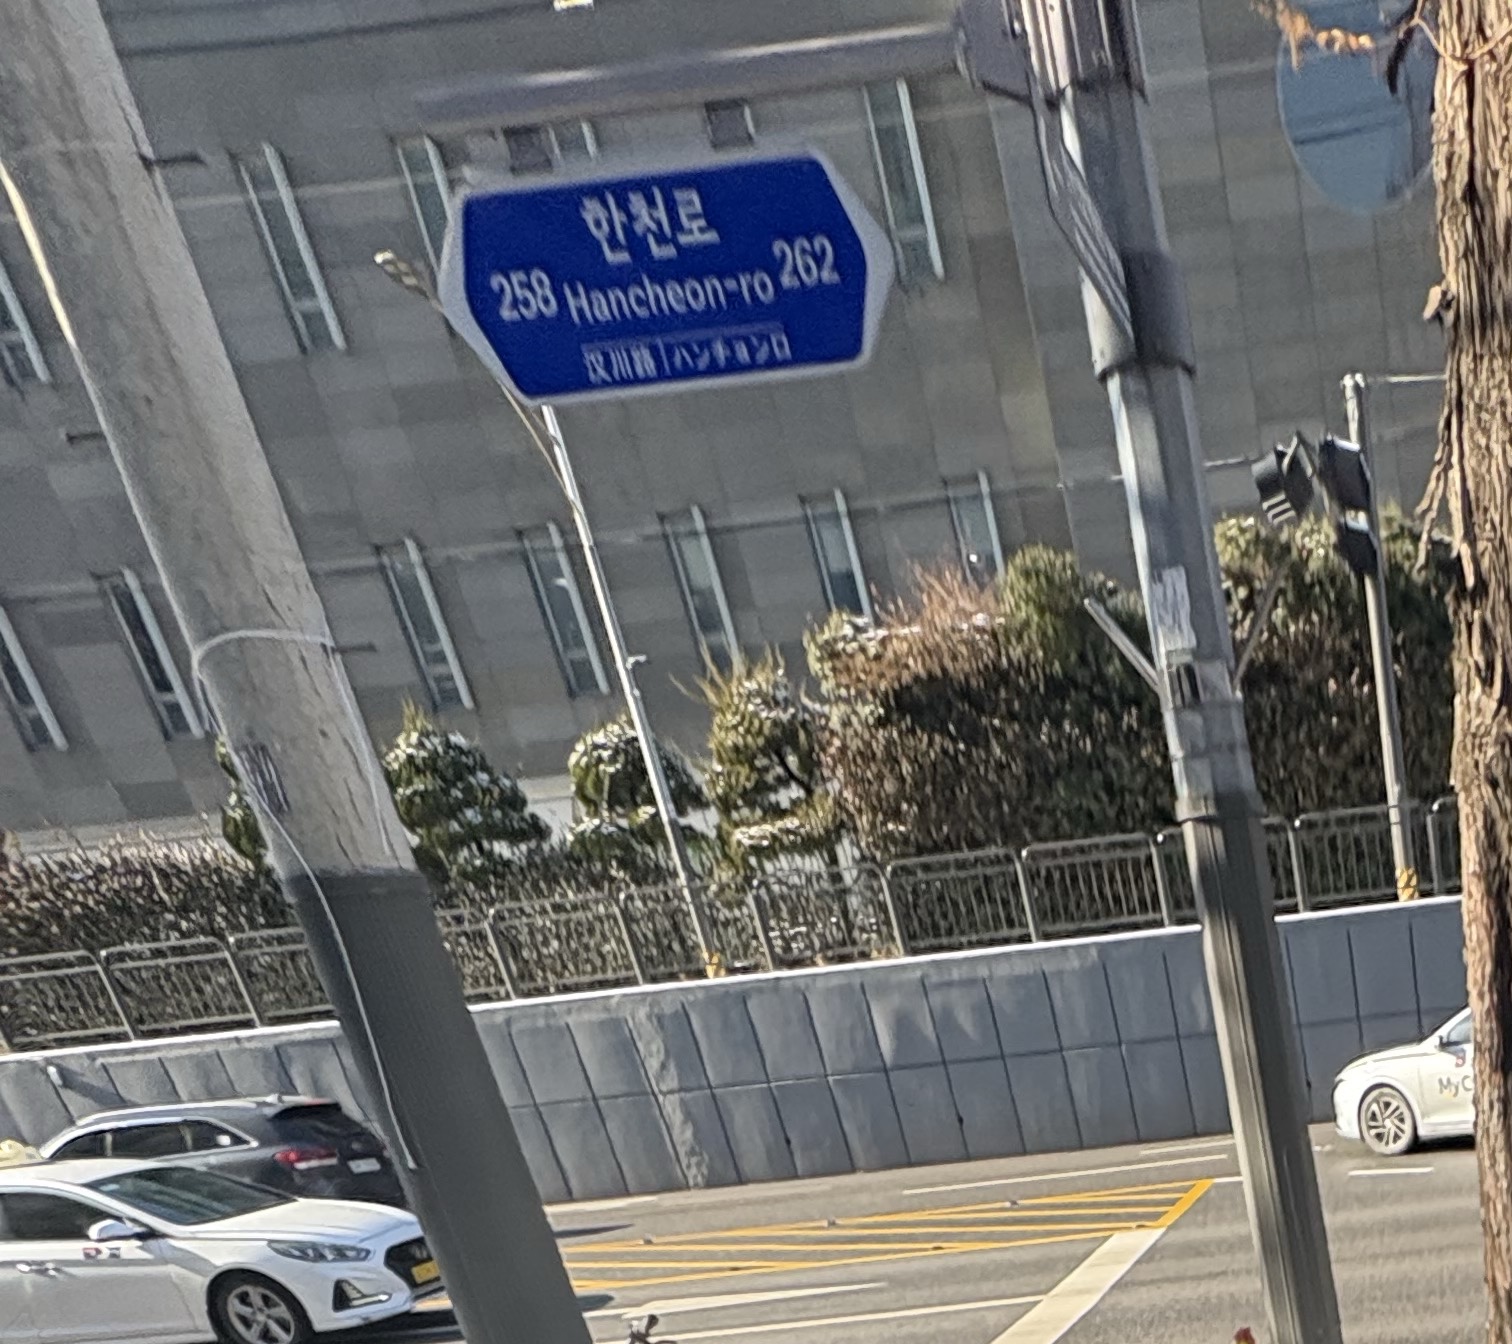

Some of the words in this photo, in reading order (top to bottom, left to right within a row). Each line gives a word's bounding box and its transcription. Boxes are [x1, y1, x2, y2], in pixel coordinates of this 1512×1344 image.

[579, 185, 720, 266] 한천로
[489, 268, 558, 322] 258
[563, 270, 775, 326] Hancheon-ro
[772, 235, 840, 290] 262
